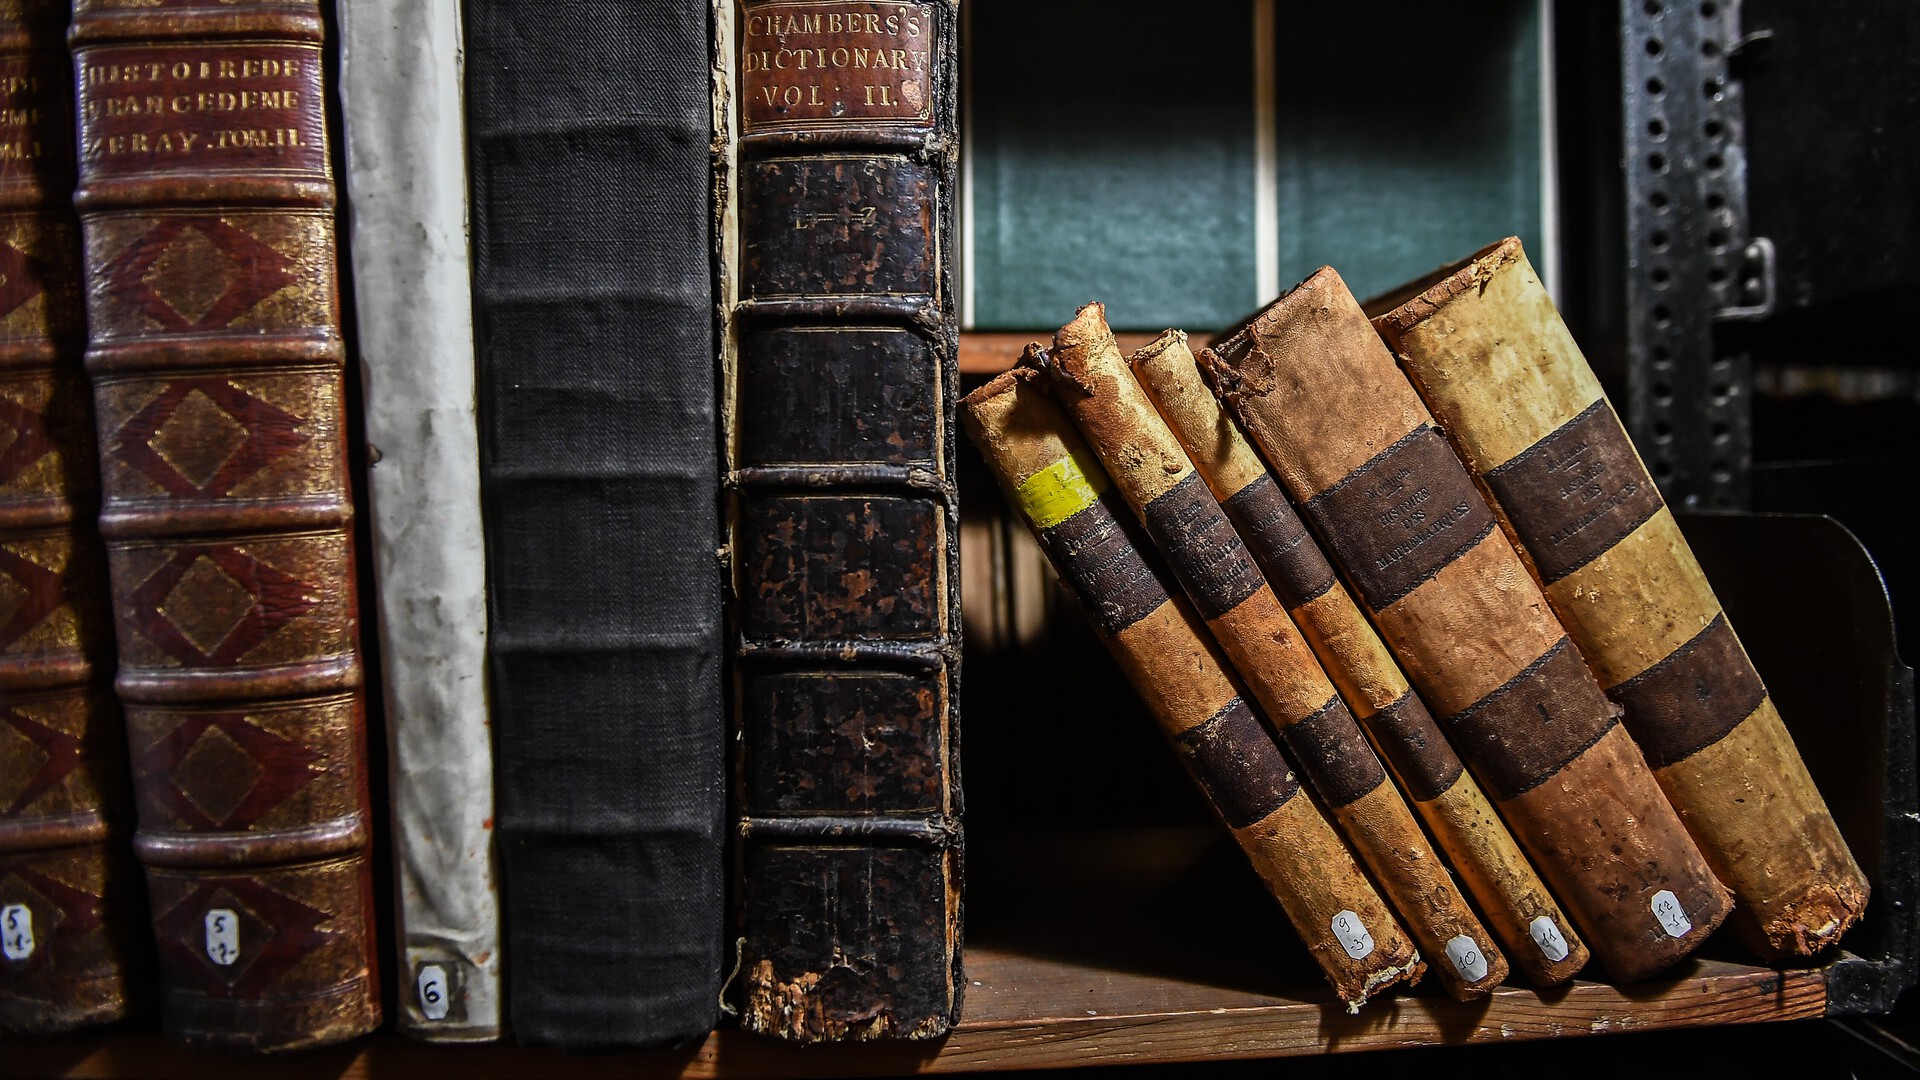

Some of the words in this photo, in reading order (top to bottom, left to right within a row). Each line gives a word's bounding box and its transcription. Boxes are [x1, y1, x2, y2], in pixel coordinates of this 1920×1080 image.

[748, 7, 921, 38] CHAMBERS'S
[746, 48, 927, 73] DICTIONARY
[1403, 510, 1427, 530] DES
[1339, 917, 1351, 932] 9
[1458, 950, 1477, 971] 10
[423, 981, 440, 1003] 6
